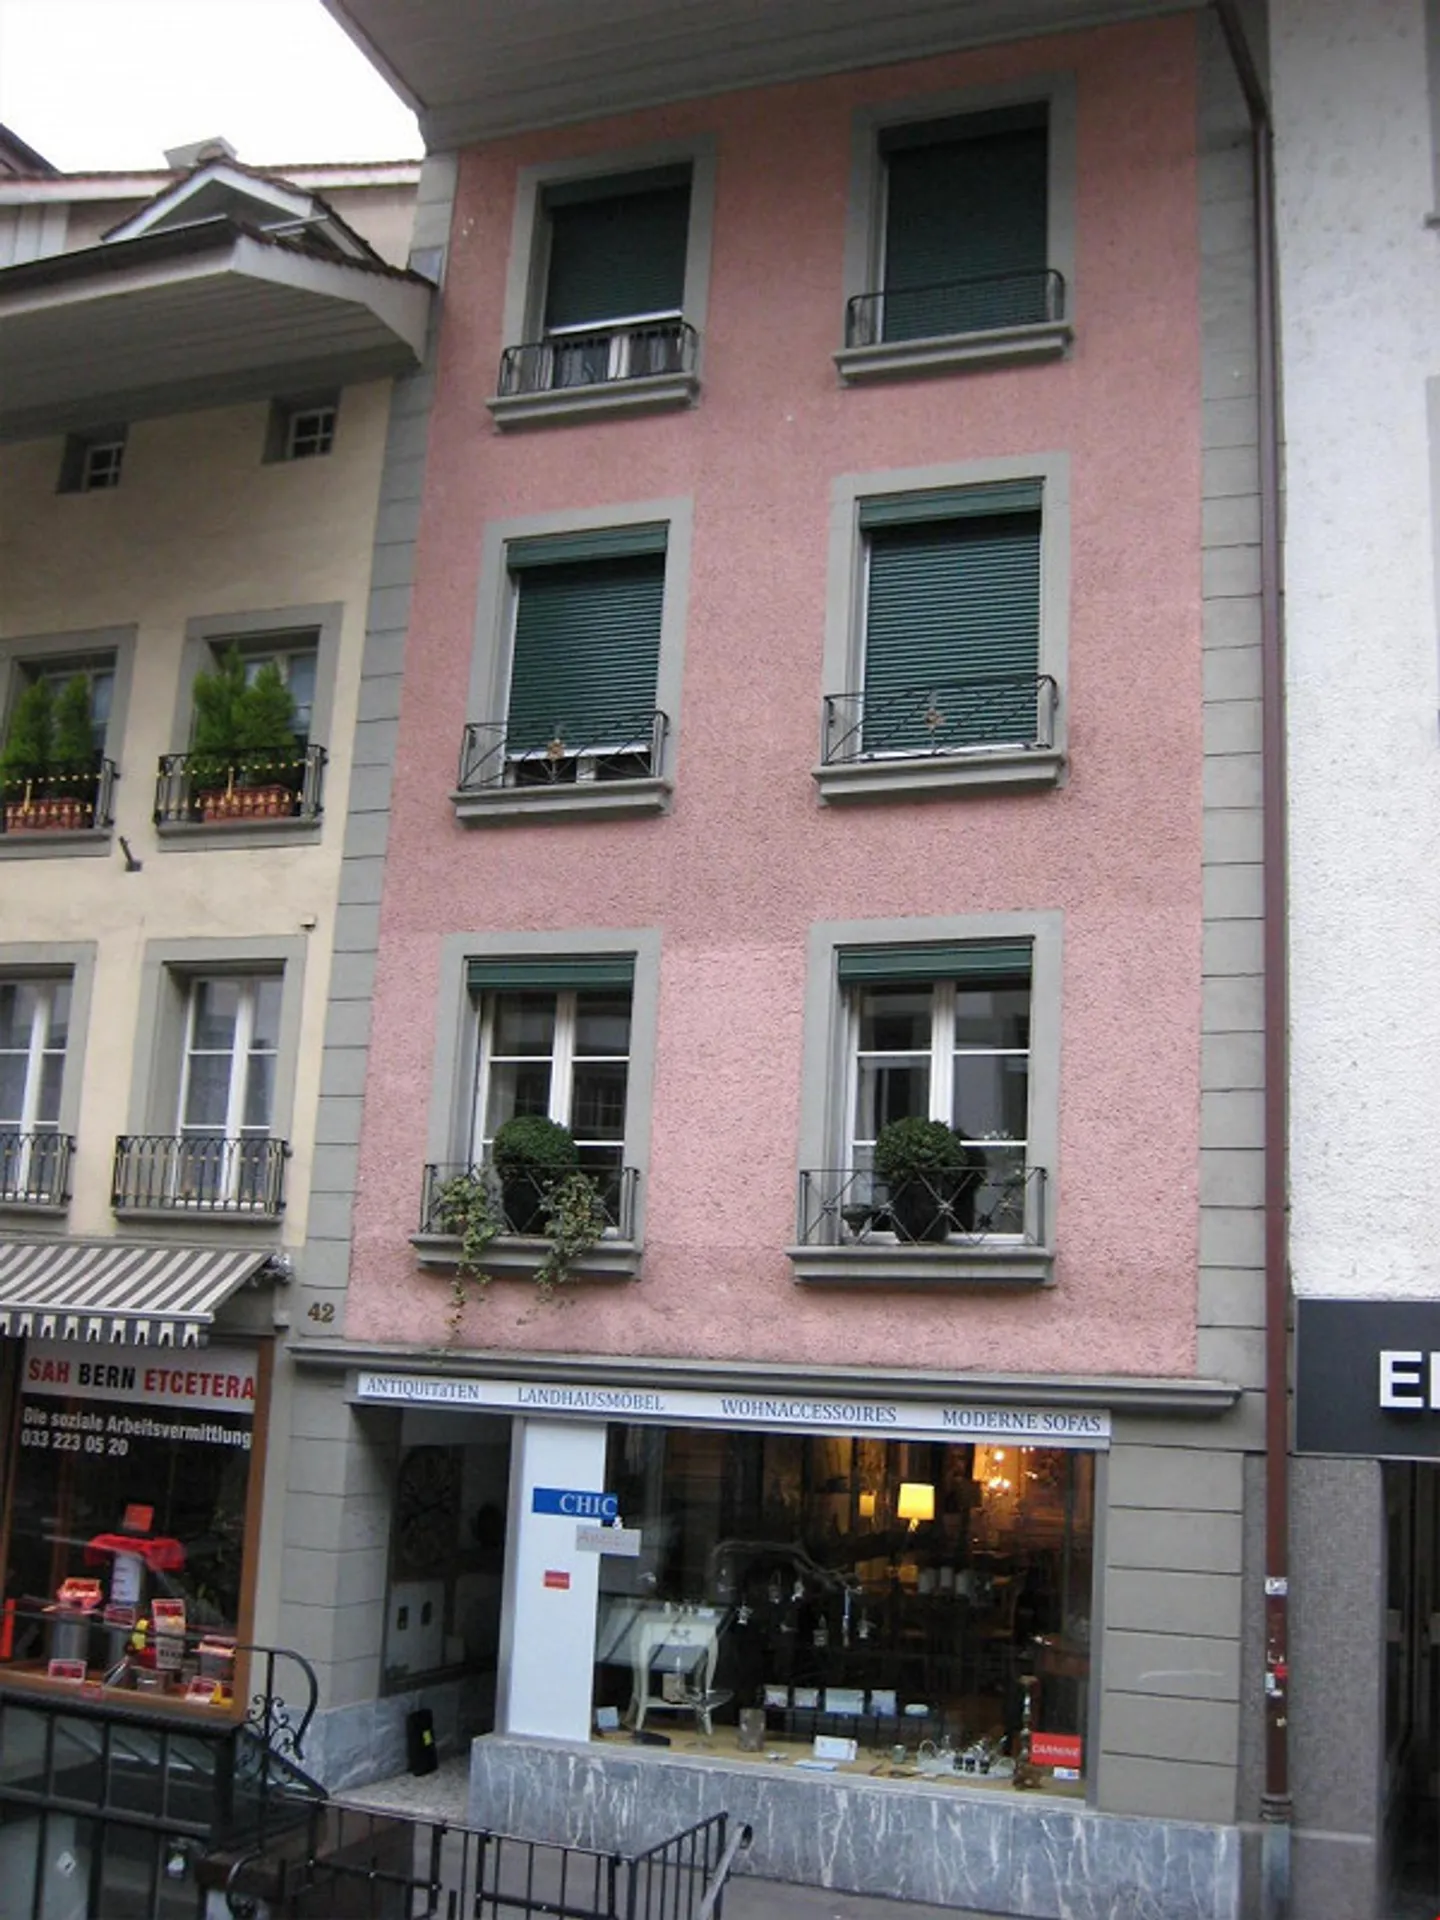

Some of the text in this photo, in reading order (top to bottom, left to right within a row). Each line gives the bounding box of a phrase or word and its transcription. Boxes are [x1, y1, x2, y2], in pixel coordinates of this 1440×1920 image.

[308, 1303, 335, 1323] 42
[29, 1358, 256, 1399] SAH BERN ETCETERA
[23, 1407, 252, 1449] Die soziale Arbeitsvermittlung
[721, 1399, 897, 1423] WOHNACCESSOIRES
[942, 1409, 1037, 1430] MODERNE
[1042, 1413, 1101, 1432] SOFAS
[21, 1430, 128, 1456] 033 223 05 20
[560, 1493, 618, 1516] CHIC
